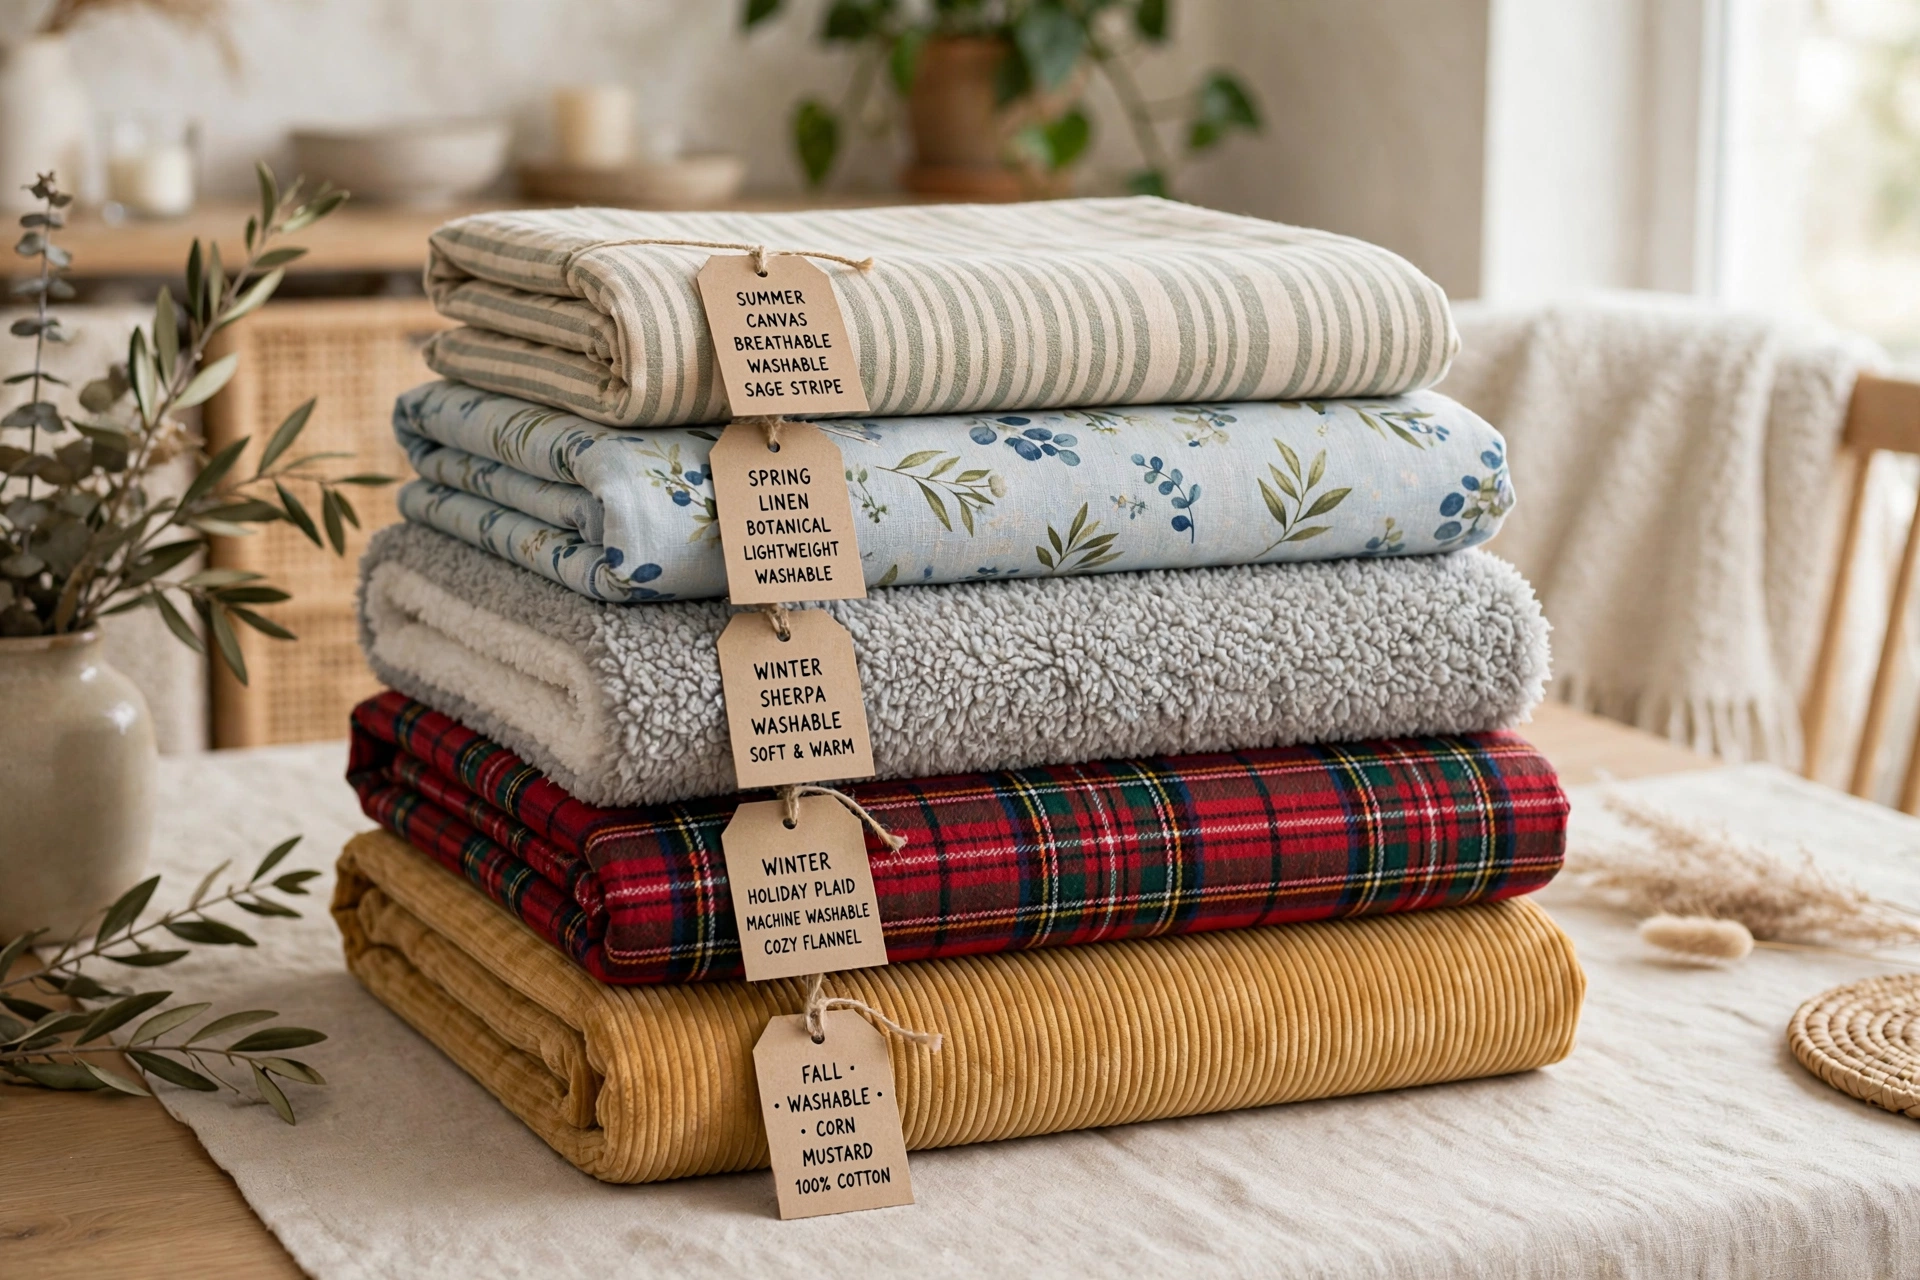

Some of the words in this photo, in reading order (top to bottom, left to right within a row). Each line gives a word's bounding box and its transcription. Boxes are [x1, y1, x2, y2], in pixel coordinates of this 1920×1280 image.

[737, 290, 805, 306] SUMMER
[747, 313, 807, 328] CANVAS
[734, 334, 831, 351] BREATHABLE
[747, 356, 828, 373] WASHABLE
[745, 381, 784, 397] SAGE
[791, 379, 843, 395] STRIPE
[749, 468, 810, 486] SPRING
[759, 493, 808, 511] LINEN
[747, 517, 831, 536] BOTANICAL
[744, 541, 838, 560] LIGHTWEIGHT
[755, 566, 832, 584] WASHABLE
[754, 658, 822, 680] WINTER
[761, 686, 826, 707] SHERPA
[751, 711, 841, 735] WASHABLE
[750, 744, 785, 762] SOFT
[794, 744, 804, 759] &
[809, 738, 854, 757] WARM
[762, 852, 831, 876] WINTER
[748, 883, 807, 904] HOLIDAY
[815, 878, 855, 897] PLAID
[747, 911, 801, 931] MACHINE
[805, 903, 870, 923] WASHABLE
[765, 937, 797, 955] COZY
[803, 929, 862, 950] FLANNEL
[802, 1063, 842, 1084] FALL
[787, 1087, 870, 1112] WASHABLE
[817, 1117, 855, 1136] CORN
[803, 1143, 872, 1167] MUSTARD
[796, 1176, 831, 1194] 100%
[838, 1167, 890, 1189] COTTON
